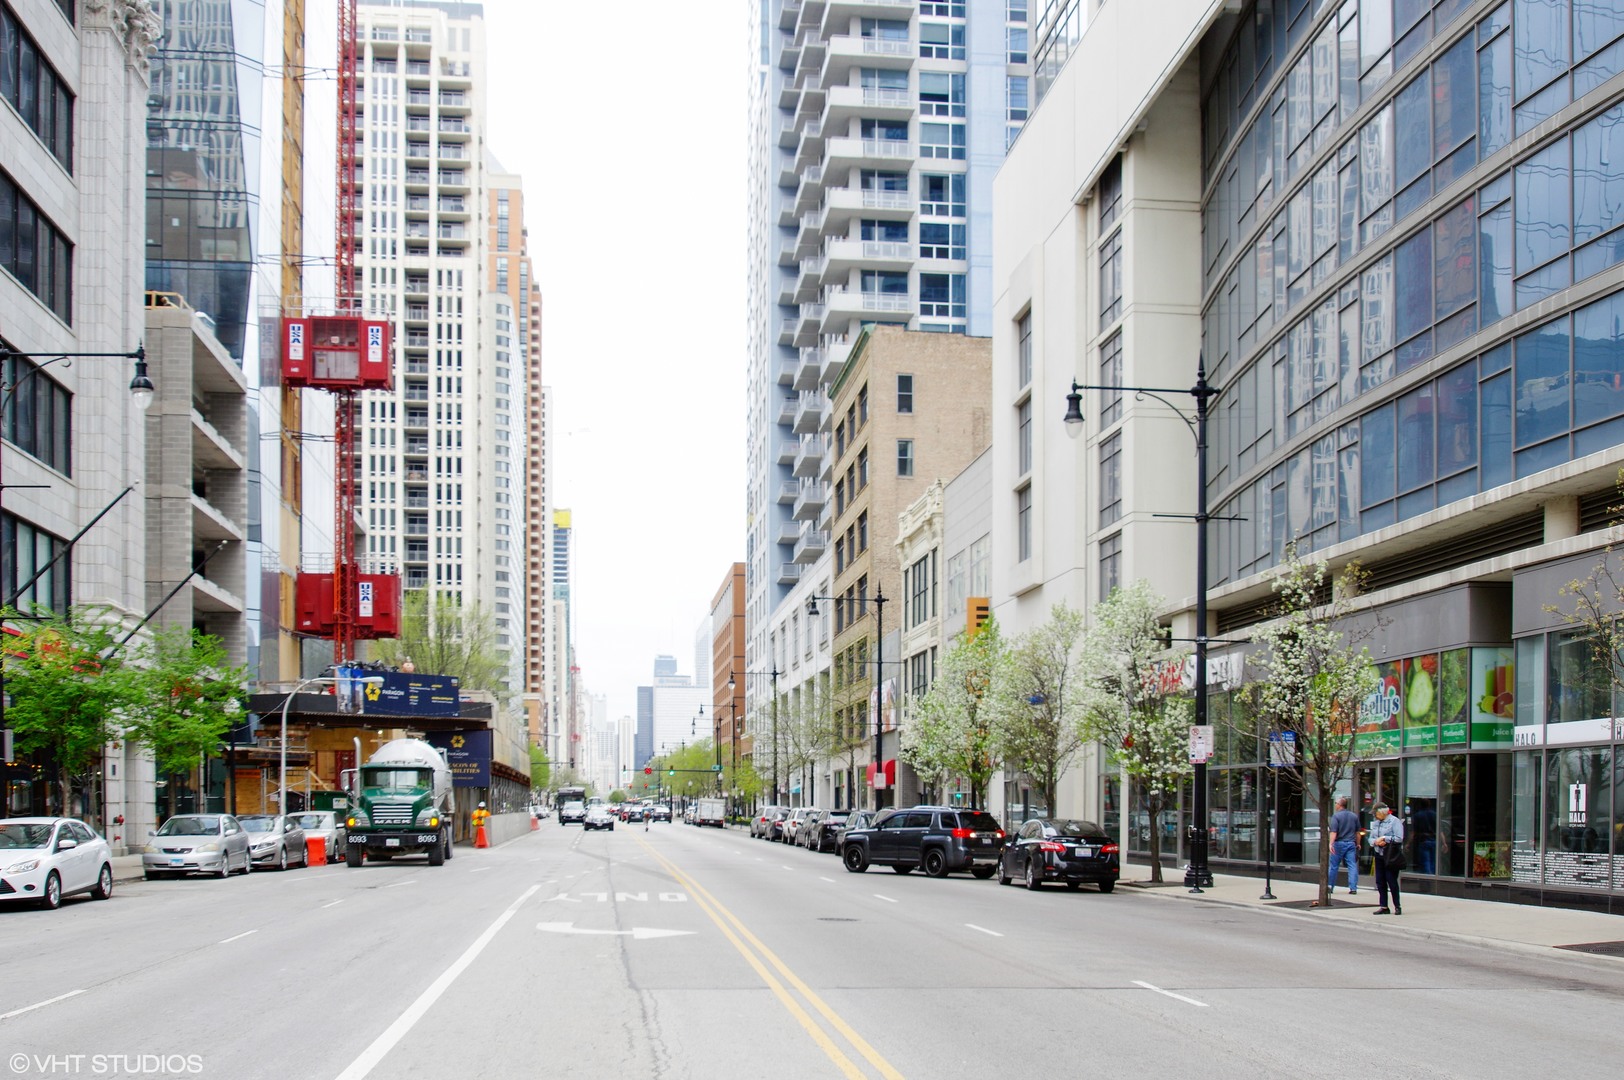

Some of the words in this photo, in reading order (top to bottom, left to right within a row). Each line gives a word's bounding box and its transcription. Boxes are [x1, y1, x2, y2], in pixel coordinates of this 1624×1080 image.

[291, 325, 301, 344] USA
[370, 327, 380, 346] USA
[361, 583, 370, 601] USA
[1492, 728, 1509, 737] Juice
[1515, 732, 1536, 747] HALO
[1568, 812, 1586, 823] HALO
[348, 835, 367, 843] 8093
[417, 834, 437, 843] 8093
